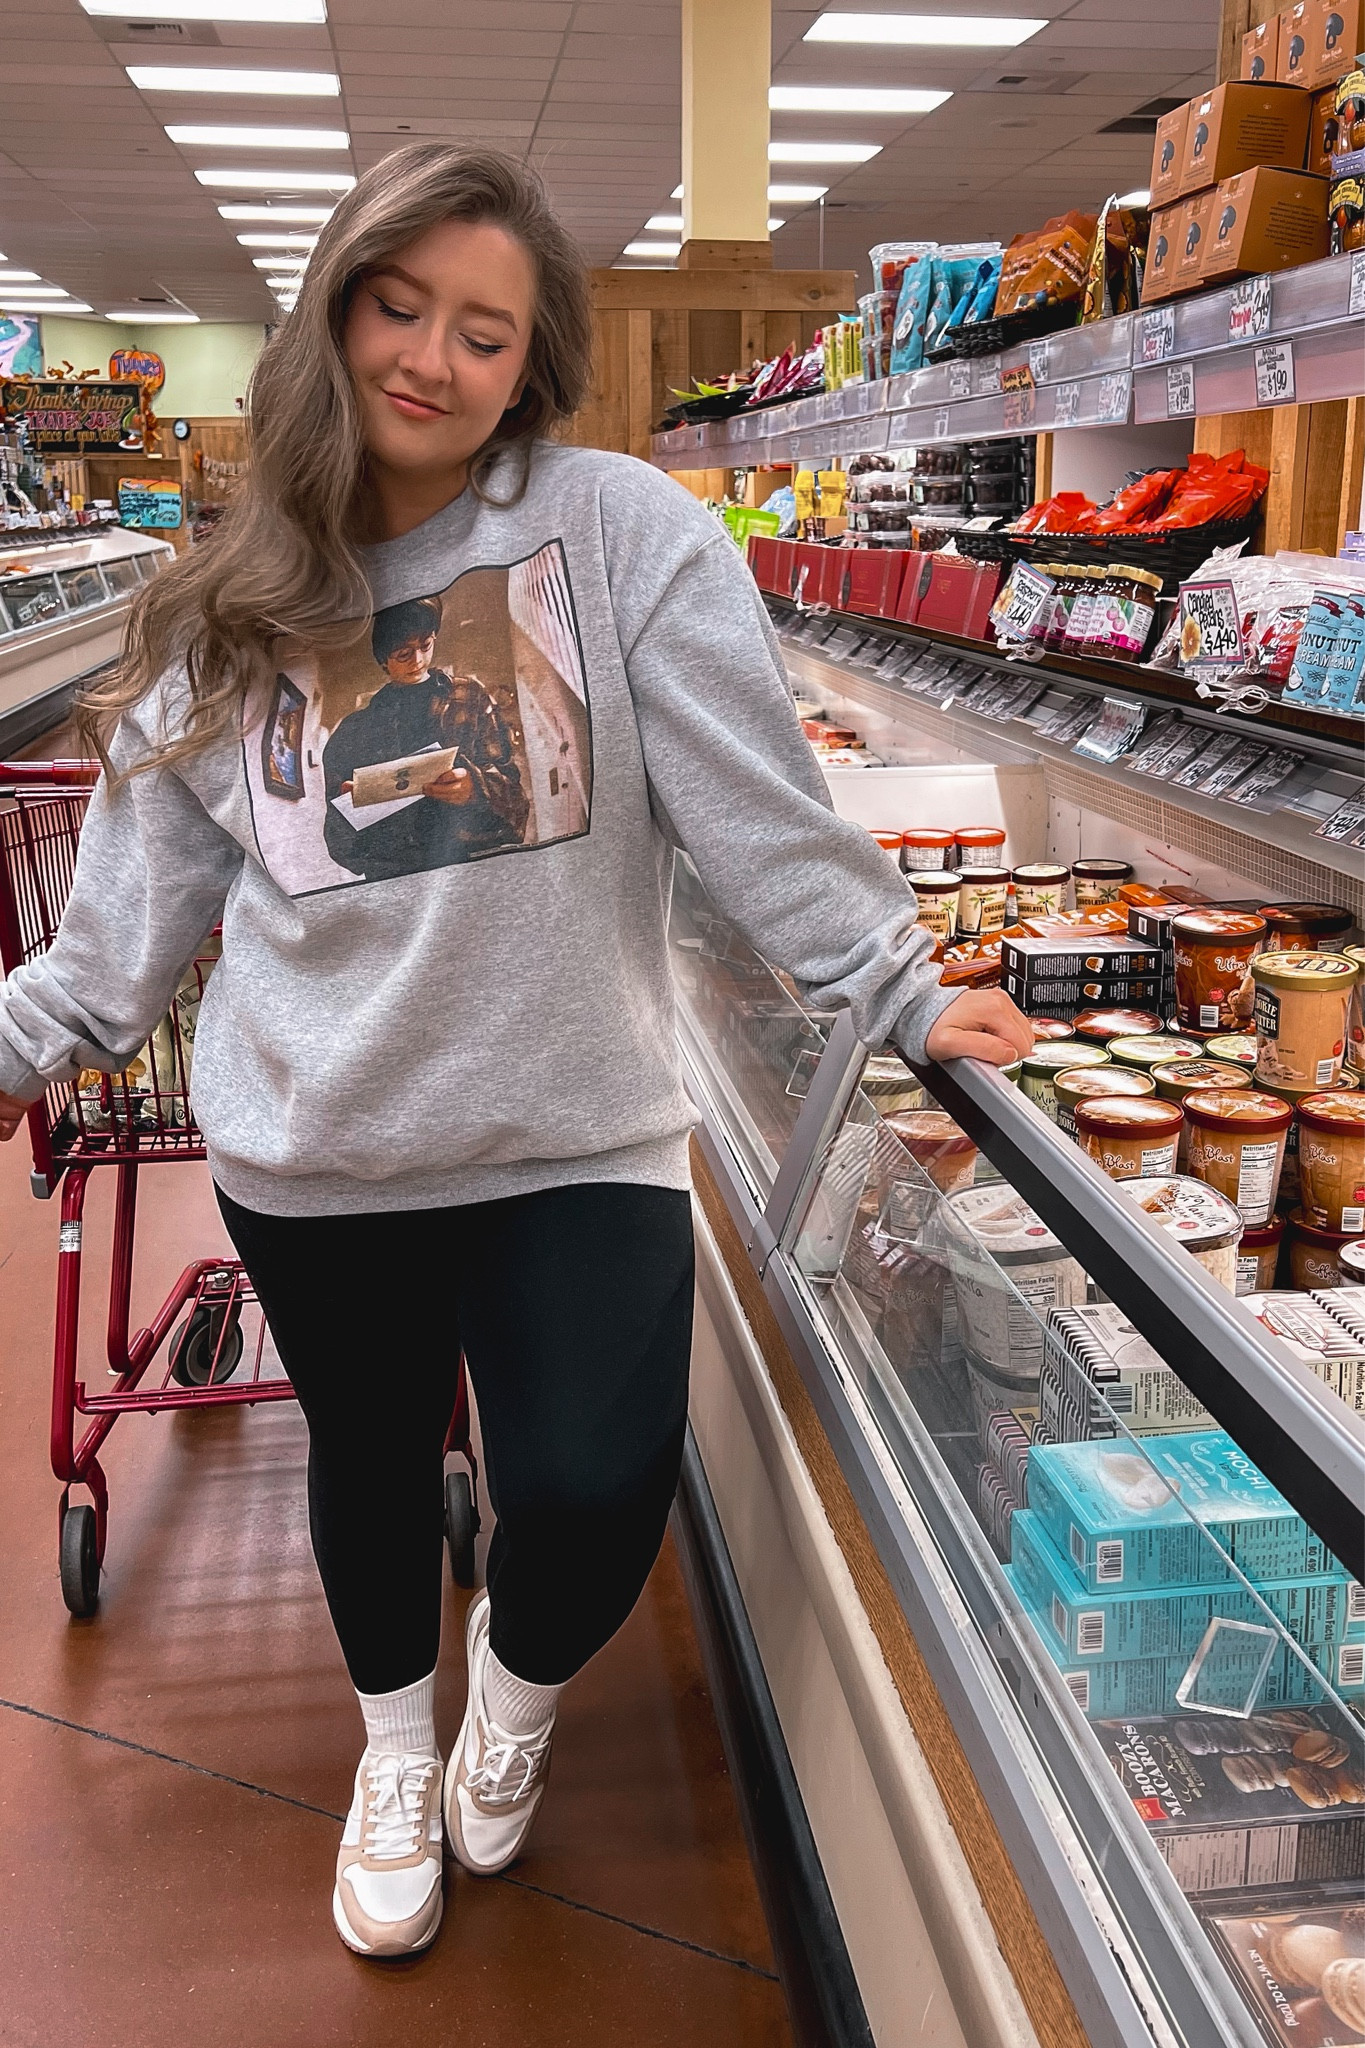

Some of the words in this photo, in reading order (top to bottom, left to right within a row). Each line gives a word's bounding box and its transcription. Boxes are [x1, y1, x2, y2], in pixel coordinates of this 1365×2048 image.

[1063, 259, 1082, 277] CHOCOL
[24, 410, 83, 430] TRADER
[1187, 589, 1214, 617] Candied
[1199, 608, 1225, 635] Pecans
[1214, 955, 1246, 973] Ultra
[1031, 1090, 1057, 1106] Min
[1104, 1153, 1135, 1170] Blast
[1205, 1145, 1235, 1164] Blast
[1310, 1144, 1337, 1165] Blast
[1305, 1258, 1338, 1279] Coffee
[1038, 1276, 1055, 1285] Facts
[1043, 1294, 1056, 1302] 330
[1355, 1361, 1365, 1391] Nutrition
[1354, 1391, 1364, 1410] Facts
[1221, 1450, 1271, 1490] MOCHI
[1308, 1545, 1318, 1555] 80
[1307, 1557, 1318, 1573] 490
[1324, 1586, 1337, 1620] Nutrition
[1324, 1621, 1336, 1641] Facts
[1114, 1741, 1158, 1797] BOOZY
[1122, 1725, 1187, 1817] MACARONS
[1247, 1949, 1260, 1964] NET
[1272, 1991, 1287, 2004] OZ
[1276, 2003, 1300, 2027] (120g)
